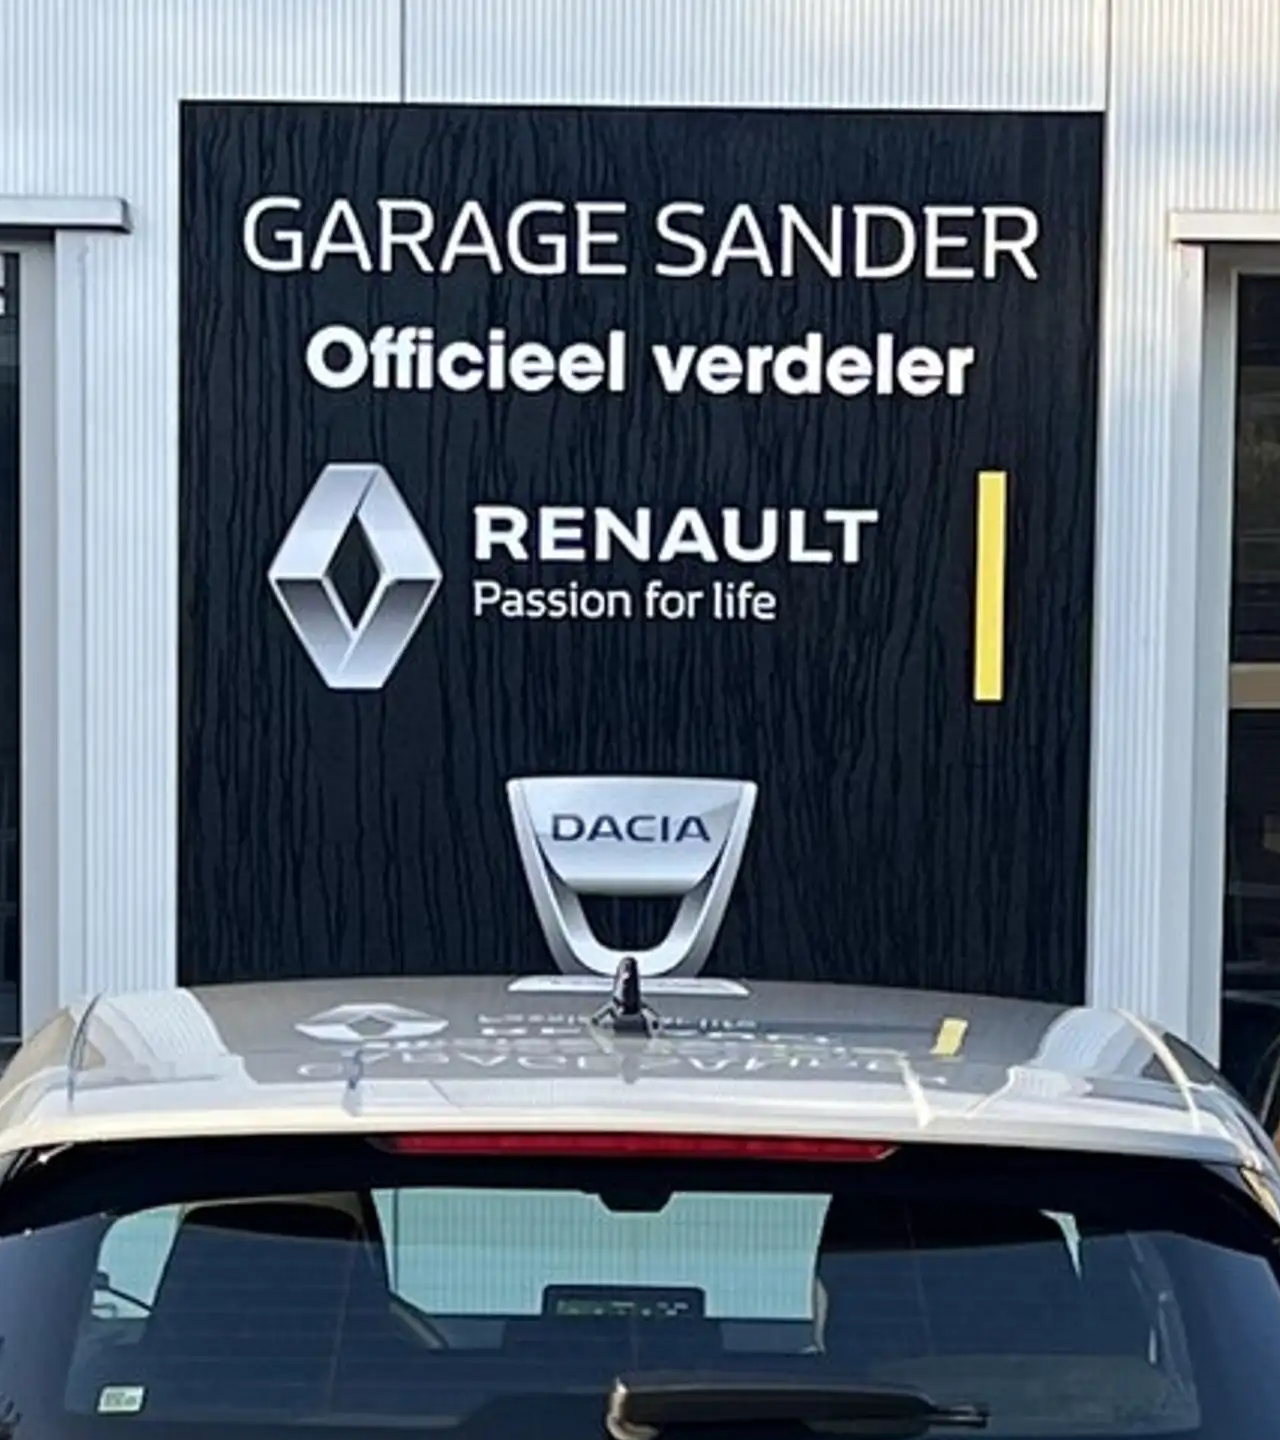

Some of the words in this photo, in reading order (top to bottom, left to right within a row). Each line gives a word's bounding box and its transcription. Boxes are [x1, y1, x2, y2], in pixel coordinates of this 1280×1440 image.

[243, 196, 627, 275] GARAGE
[655, 202, 1038, 280] SANDER
[306, 324, 626, 392] Officieel
[652, 332, 975, 396] verdeler
[474, 505, 879, 563] RENAULT
[473, 580, 632, 619] Passion
[645, 579, 703, 620] for
[713, 580, 777, 620] life
[551, 815, 711, 843] DACIA
